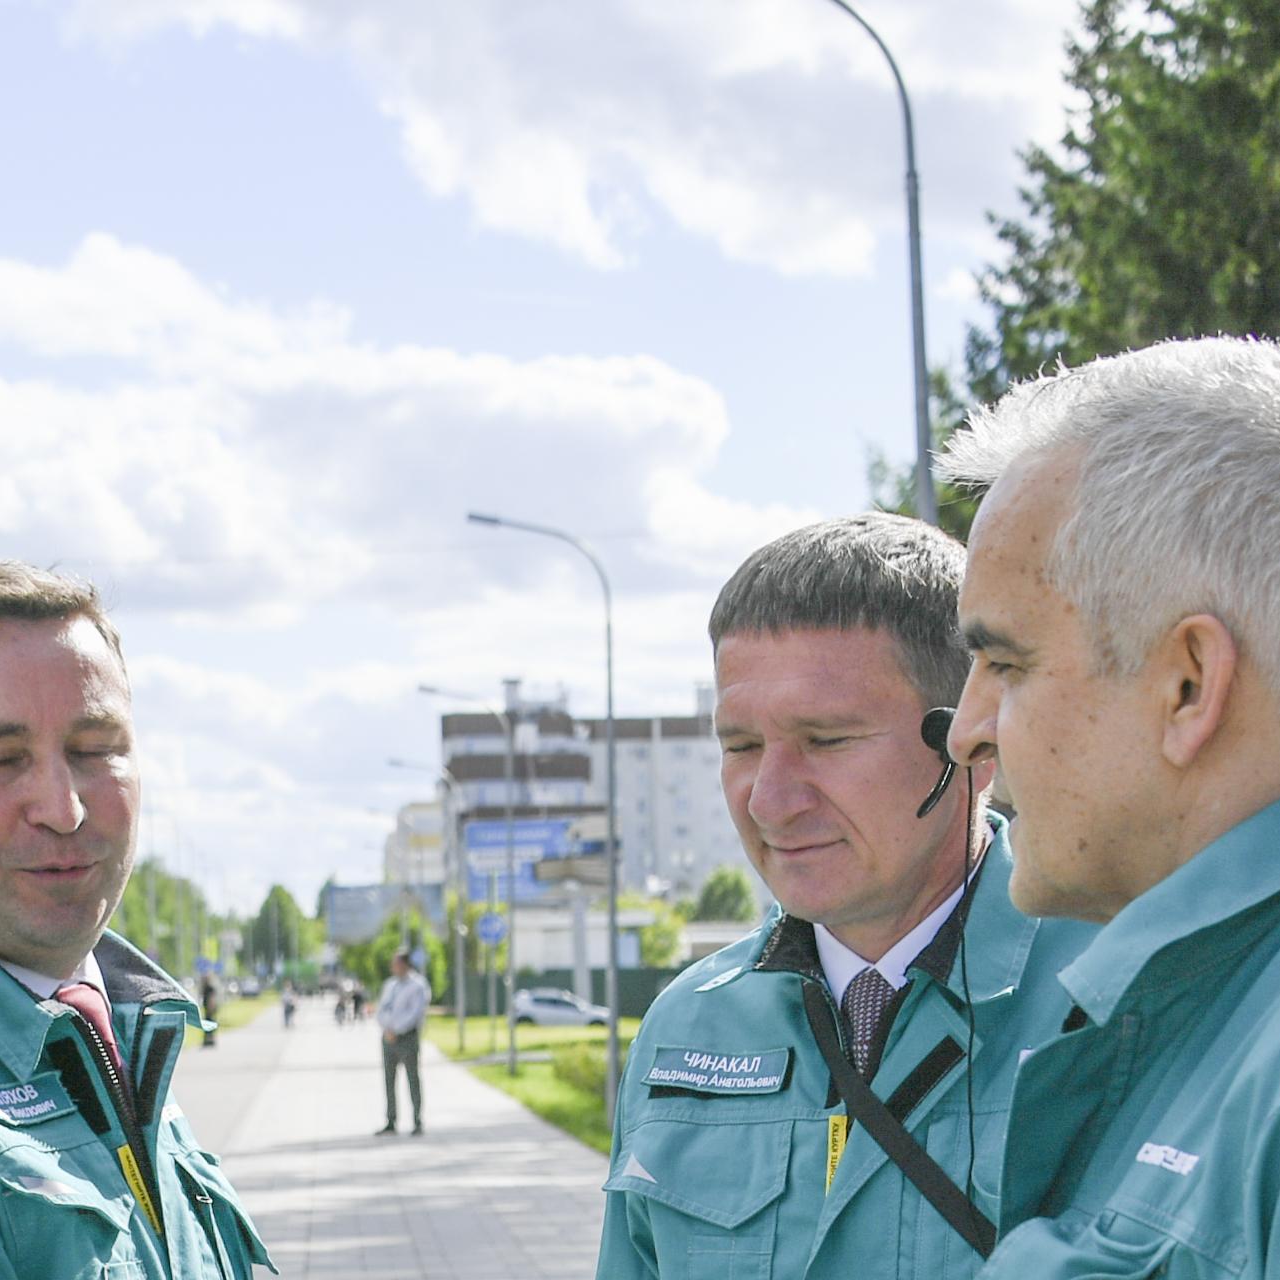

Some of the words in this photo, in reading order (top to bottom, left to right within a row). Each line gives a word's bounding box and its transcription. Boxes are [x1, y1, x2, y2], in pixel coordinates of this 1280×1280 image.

[683, 1051, 762, 1073] ЧИНАКАЛ
[649, 1067, 708, 1086] Владимир
[708, 1072, 781, 1088] Анатольевич
[831, 1122, 840, 1153] КУРТКУ
